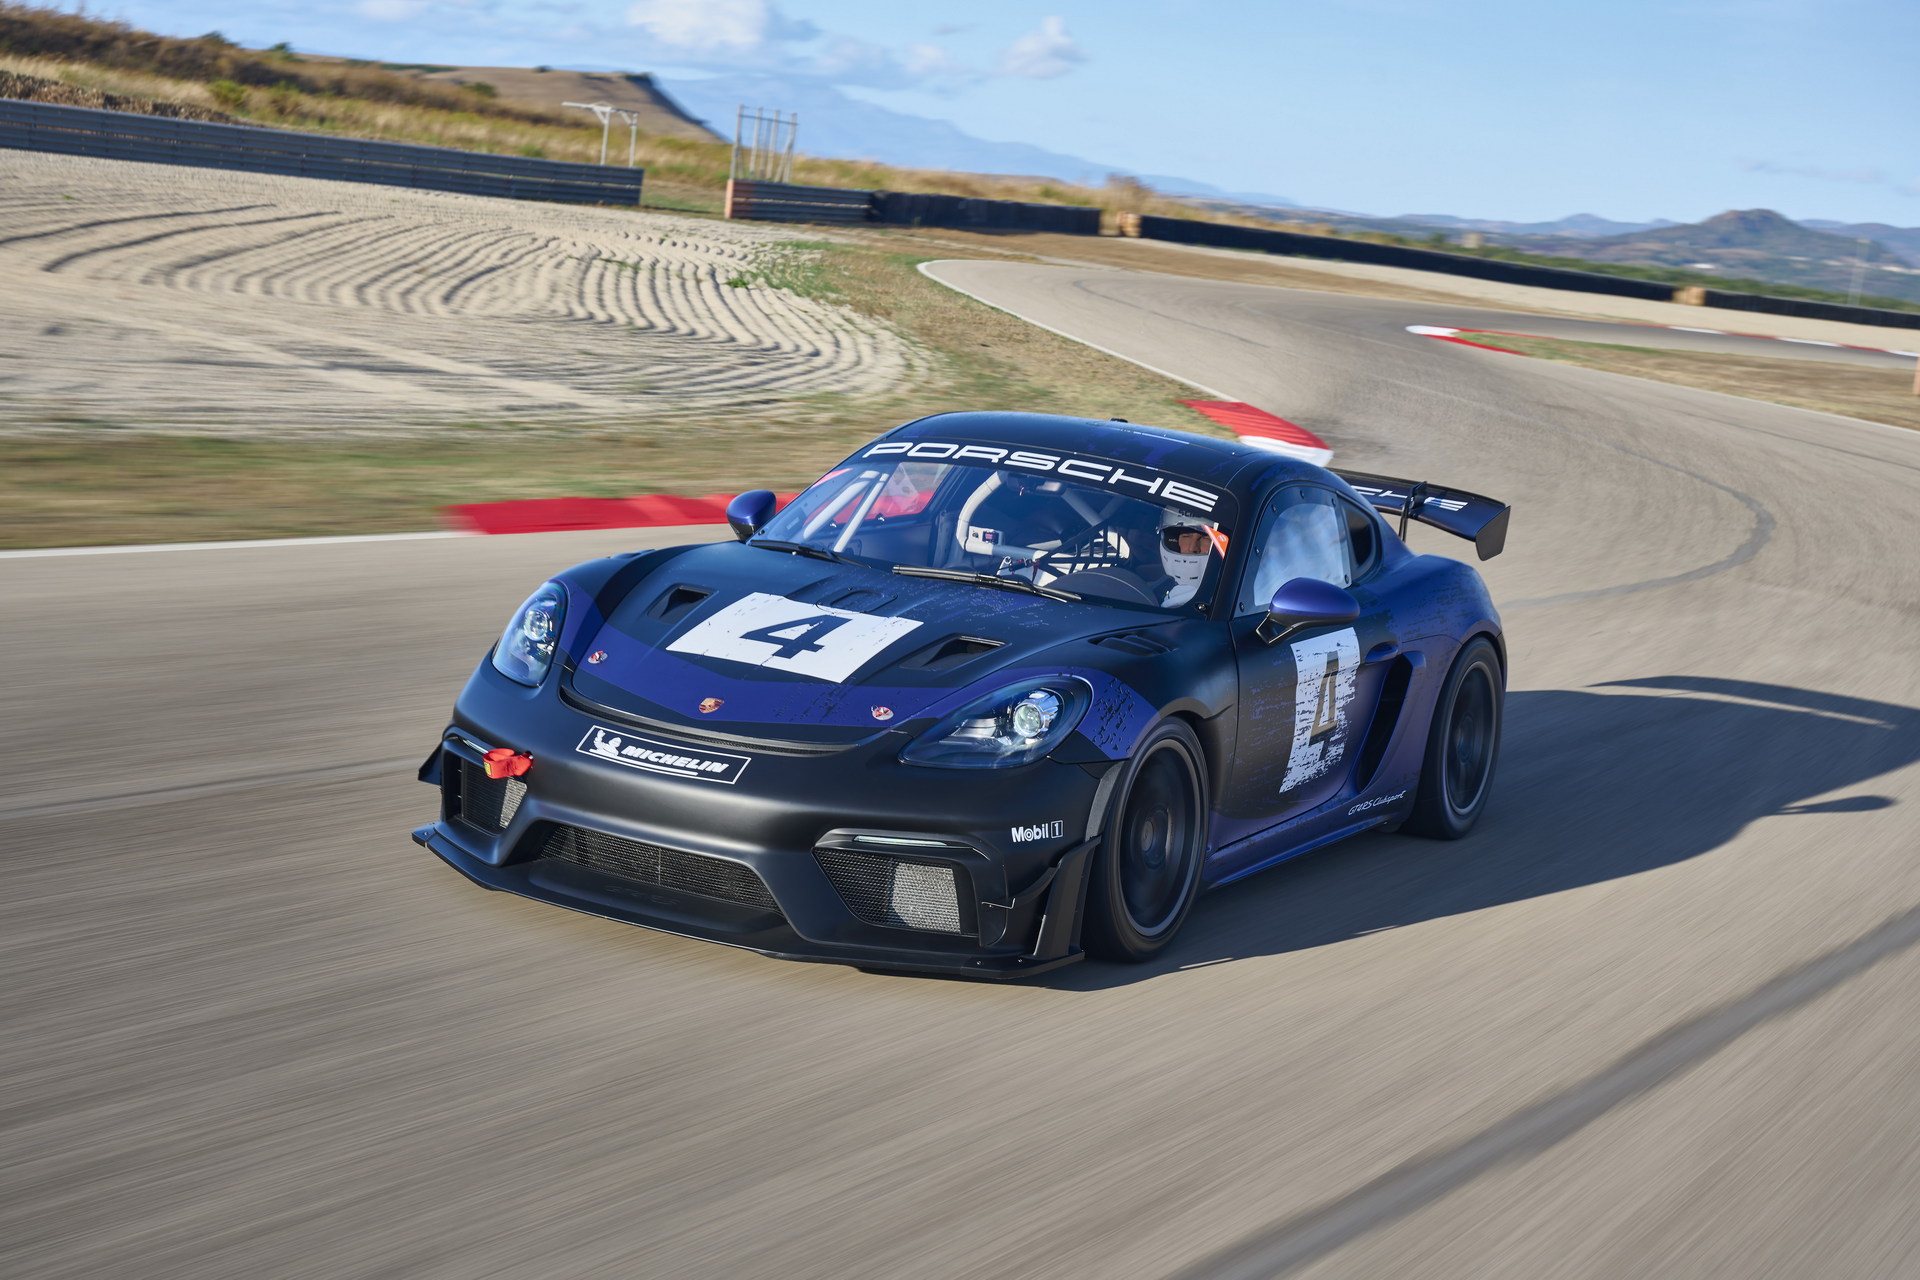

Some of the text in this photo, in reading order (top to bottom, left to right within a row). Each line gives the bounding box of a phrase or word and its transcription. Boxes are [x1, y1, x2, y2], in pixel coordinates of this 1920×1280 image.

[862, 442, 1219, 512] PORSCHE
[739, 614, 853, 659] 4
[1309, 650, 1342, 761] 4
[621, 745, 729, 773] MICHELIN
[1011, 823, 1049, 842] Mobil
